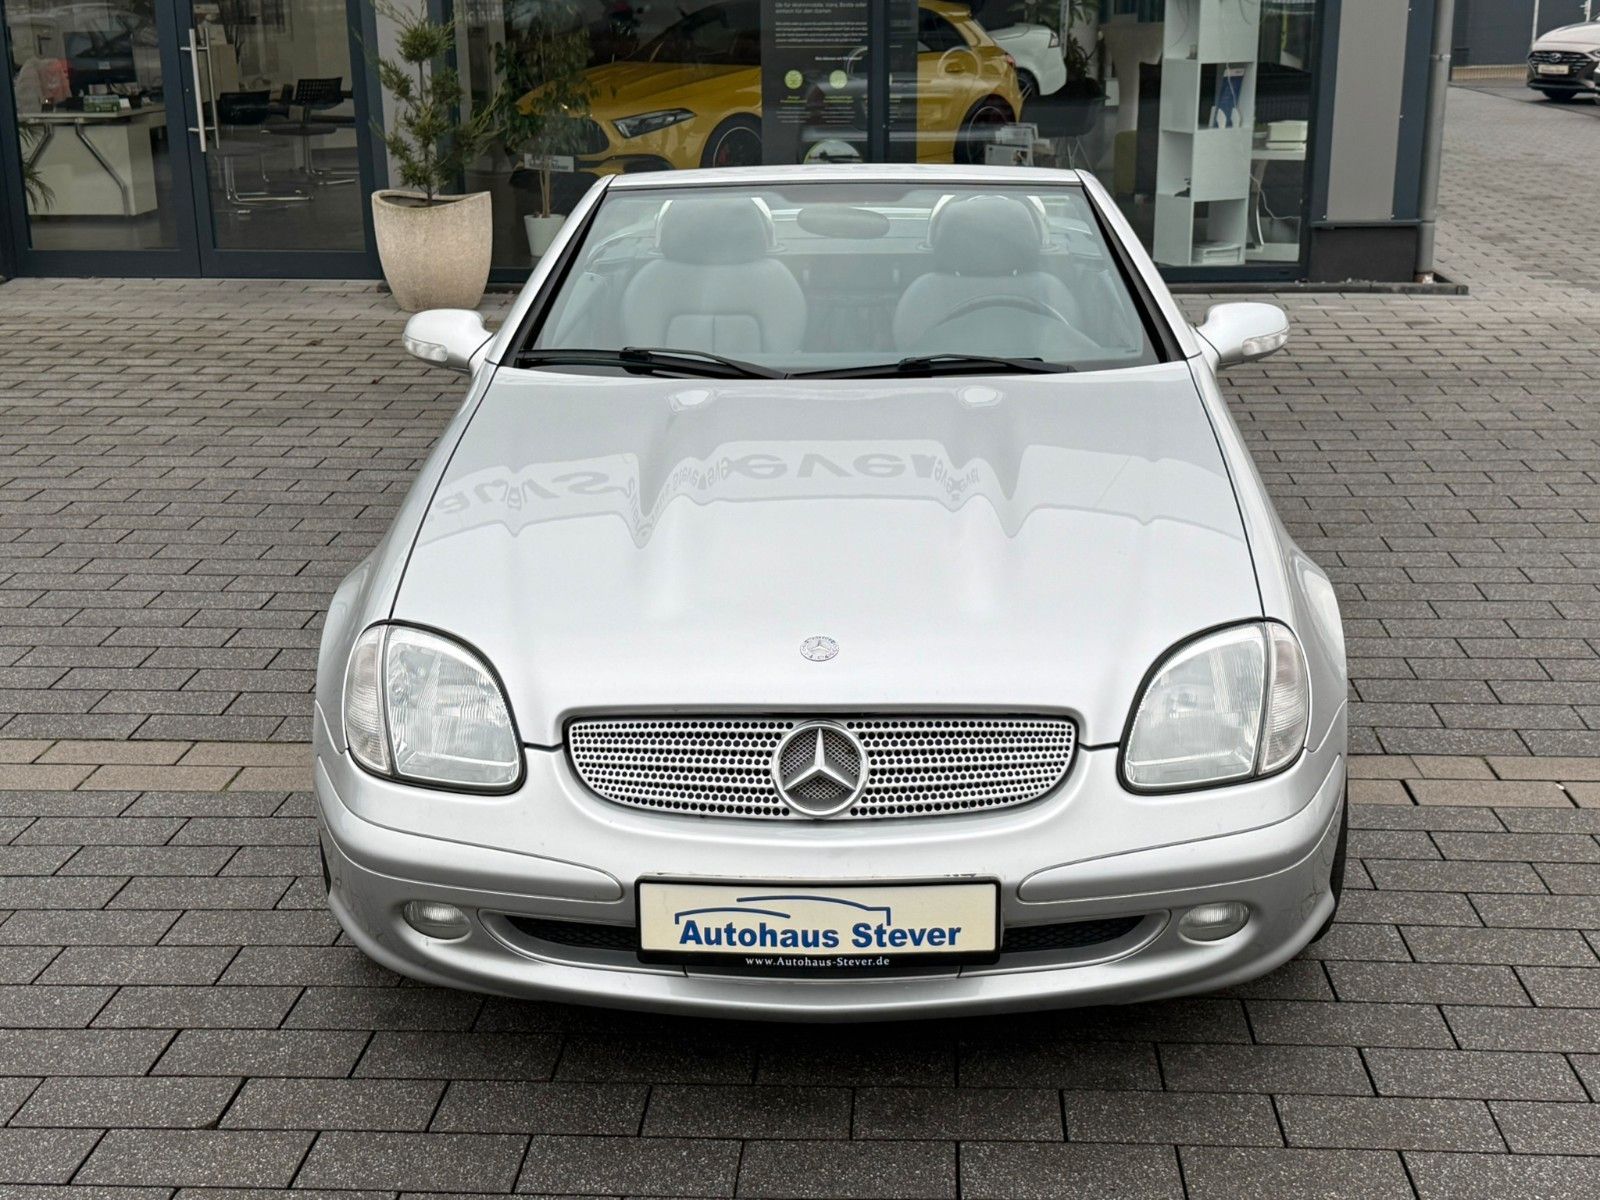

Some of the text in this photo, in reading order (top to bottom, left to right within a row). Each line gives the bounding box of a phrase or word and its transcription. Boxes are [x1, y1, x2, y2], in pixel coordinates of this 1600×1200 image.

[679, 920, 962, 949] Autohaus Stever
[745, 955, 891, 968] www.Autohaus-Stever.de
